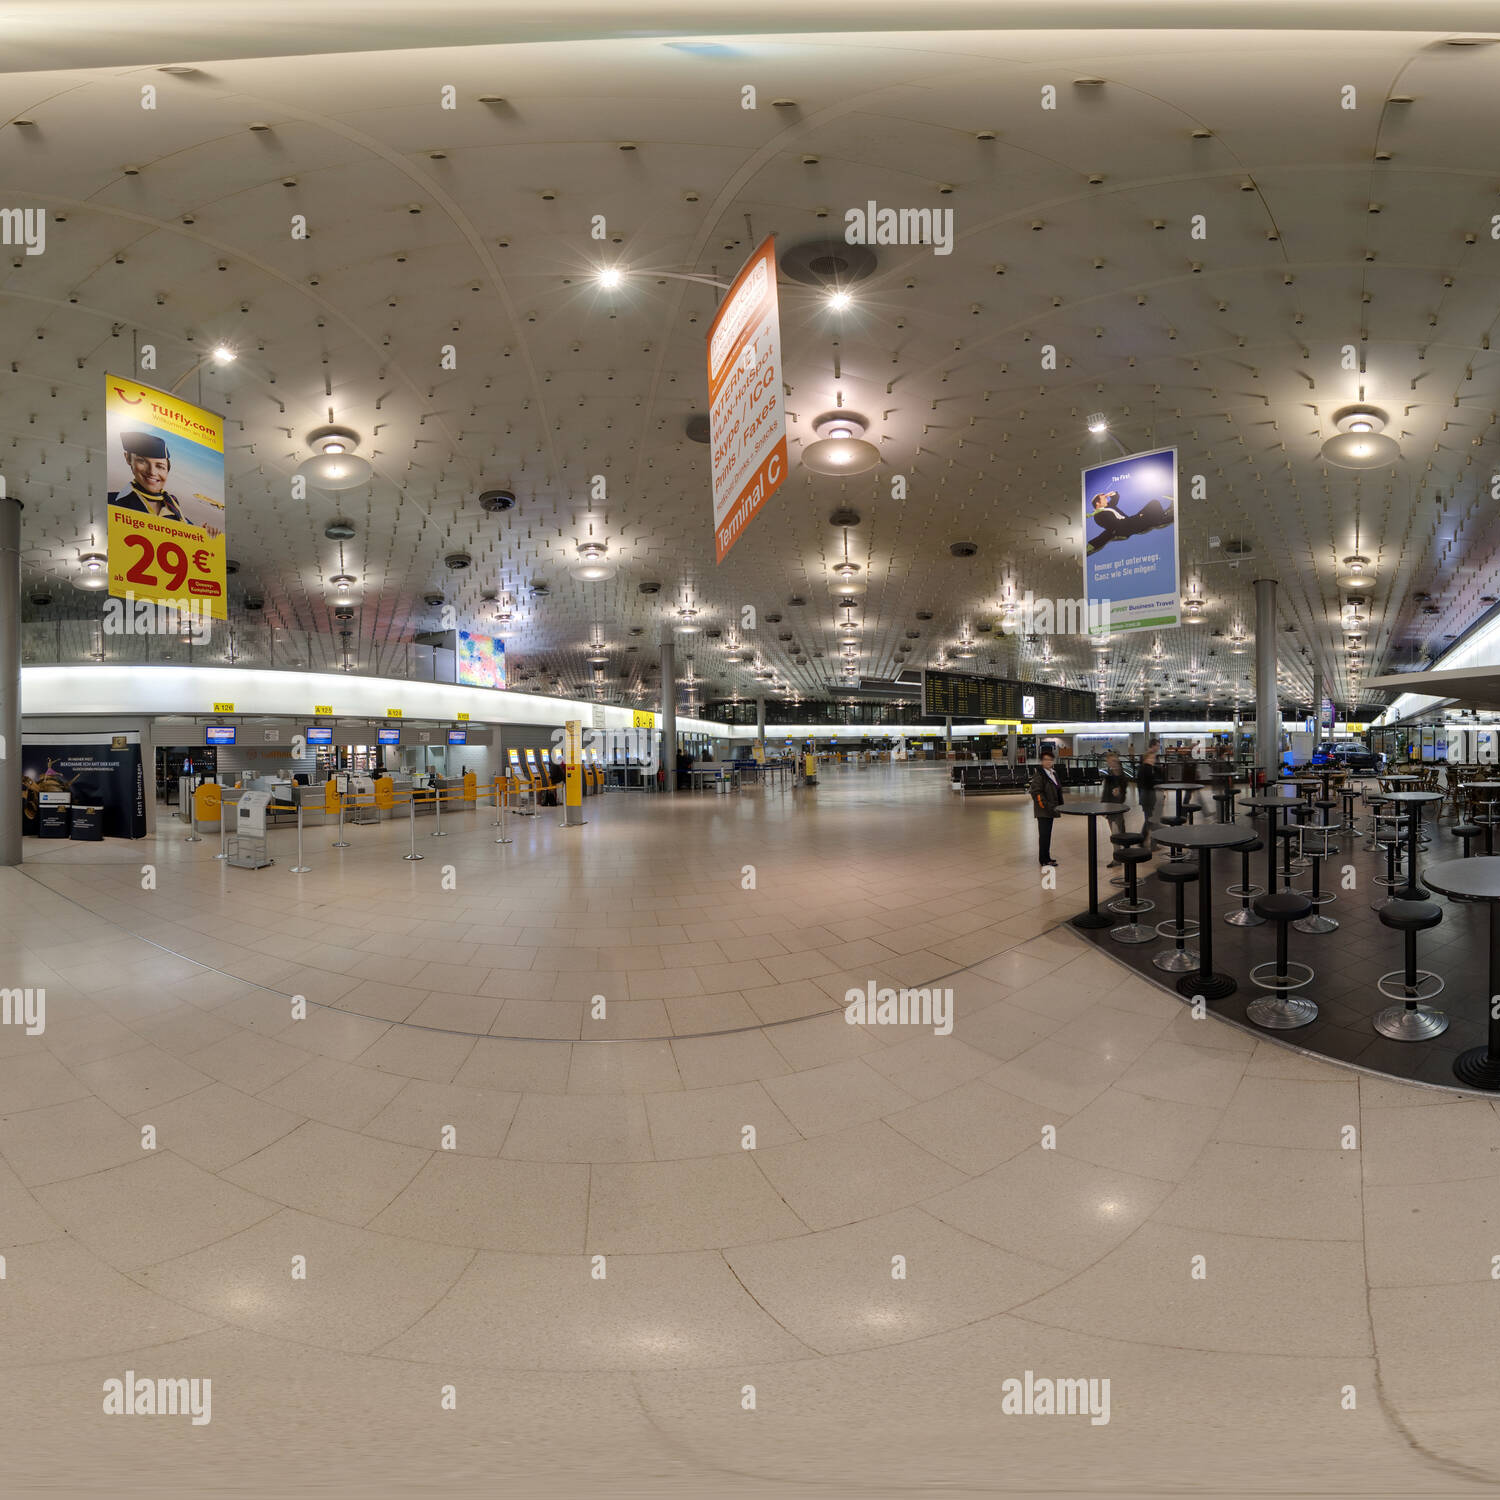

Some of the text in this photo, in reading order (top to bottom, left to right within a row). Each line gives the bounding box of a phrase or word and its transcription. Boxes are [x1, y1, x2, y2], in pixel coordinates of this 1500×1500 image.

[713, 338, 760, 427] INTERNET
[713, 343, 773, 445] WLAN-HotSpot
[714, 419, 740, 469] Skype
[750, 365, 775, 409] ICQ
[715, 453, 736, 494] Prints
[743, 394, 777, 447] Faxes
[114, 512, 205, 543] Flüge europaweit
[718, 454, 781, 552] Terminal C
[114, 573, 124, 582] ab
[123, 534, 188, 591] 29
[1094, 560, 1113, 572] Immer
[1114, 559, 1124, 570] gut
[1094, 570, 1110, 582] Ganz
[1111, 568, 1121, 579] wie
[1122, 567, 1133, 577] Sie
[1155, 599, 1174, 607] Travel
[636, 716, 641, 728] 3
[649, 718, 653, 728] 6
